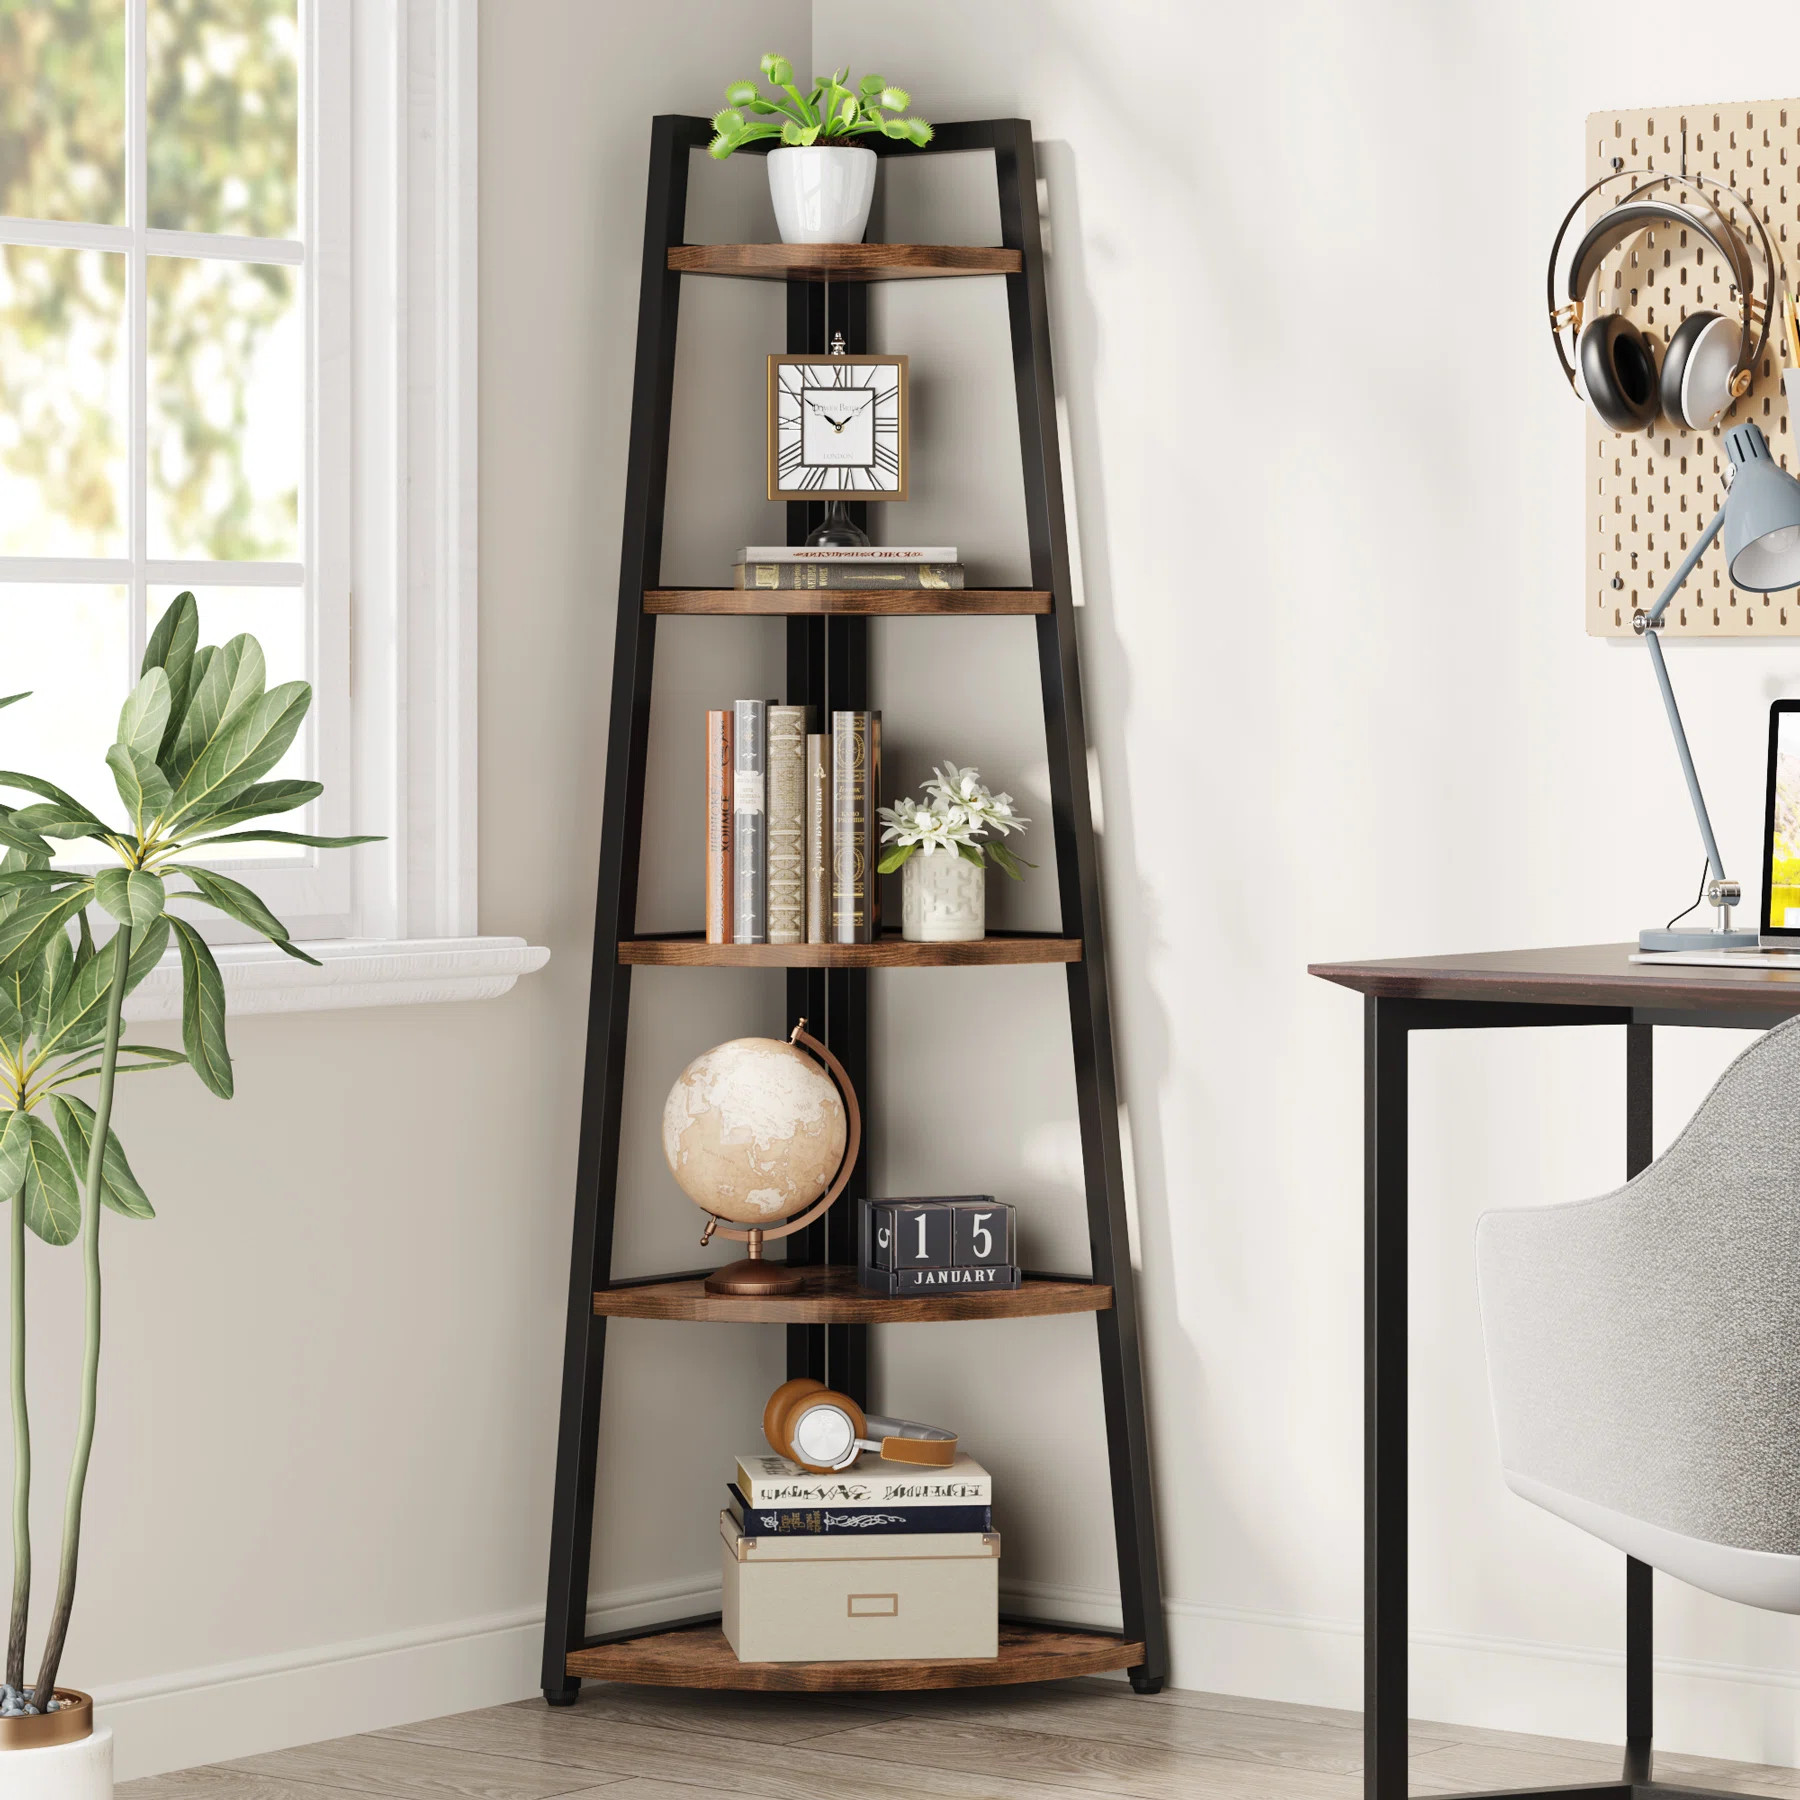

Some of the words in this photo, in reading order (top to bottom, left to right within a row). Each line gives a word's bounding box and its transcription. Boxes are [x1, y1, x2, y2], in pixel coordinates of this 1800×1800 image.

[914, 1213, 930, 1259] 1
[973, 1212, 993, 1258] 5
[914, 1269, 996, 1285] JANUARY
